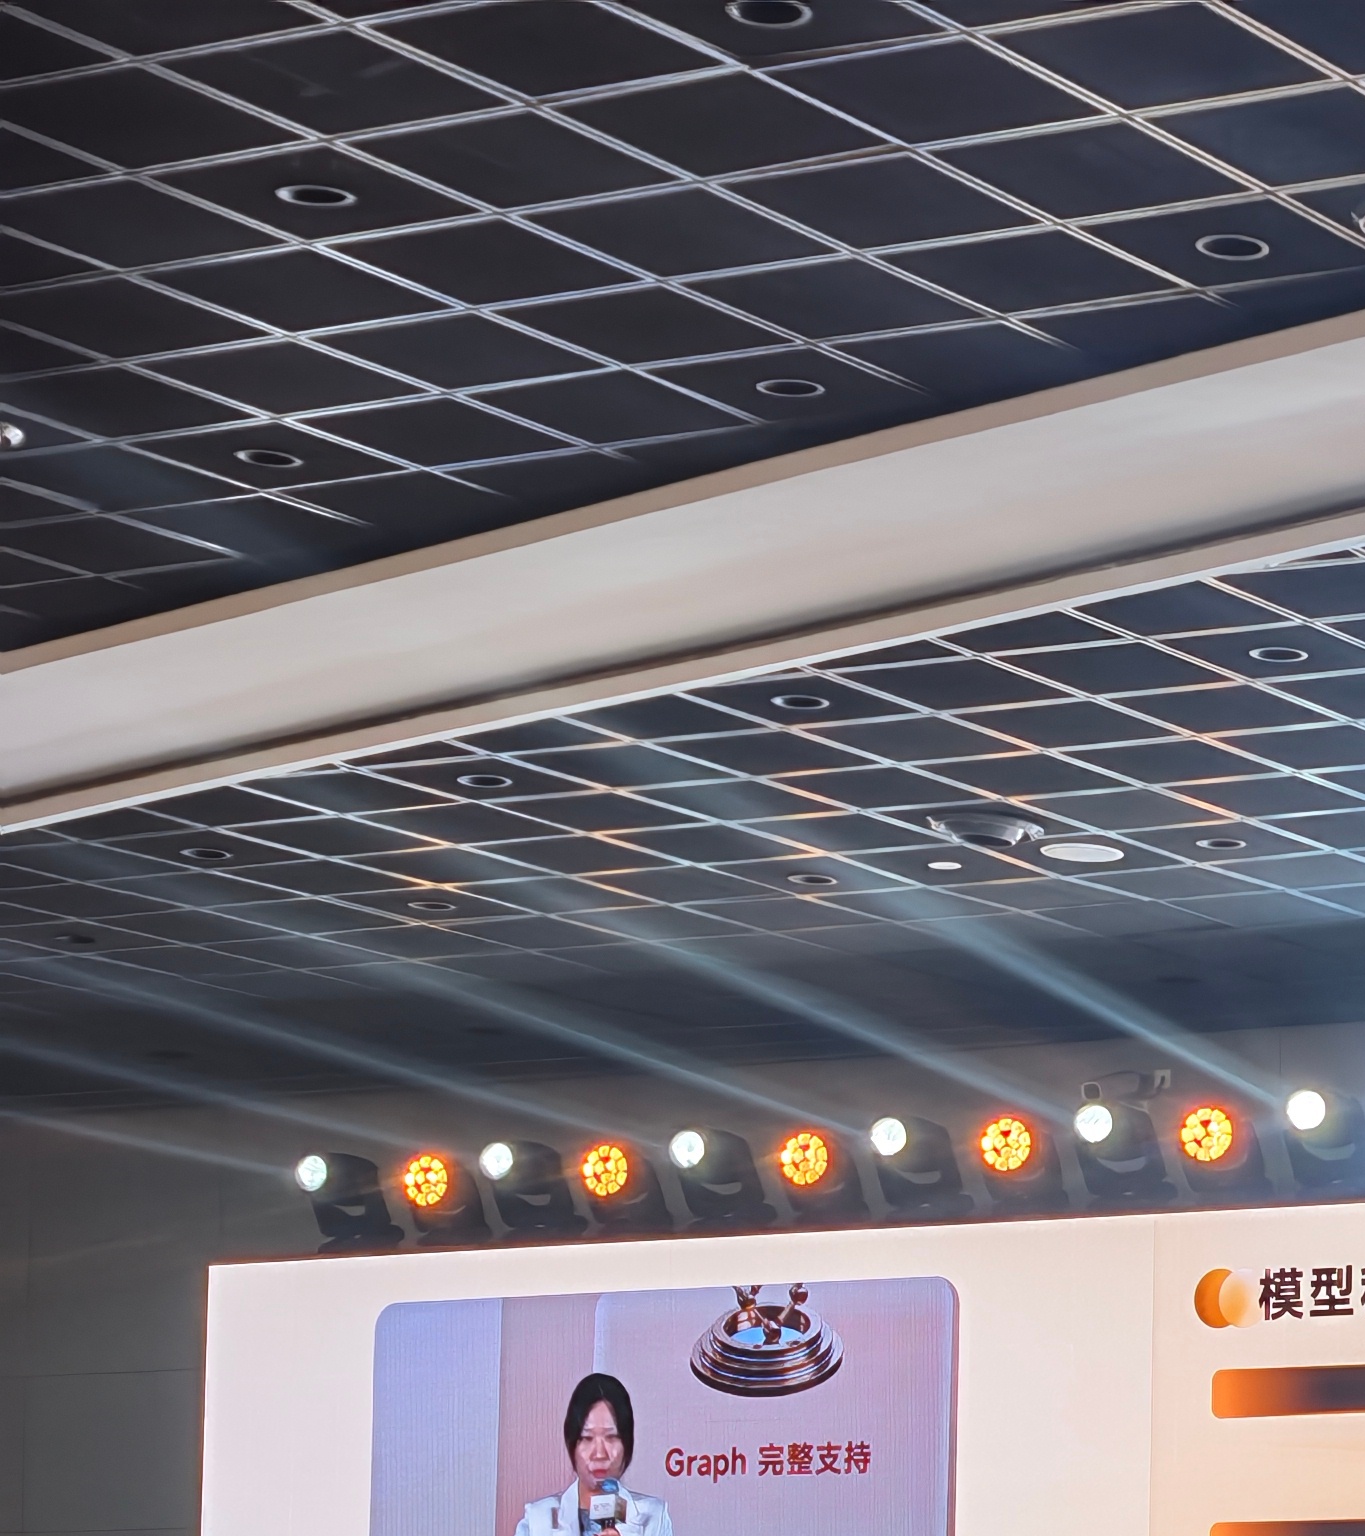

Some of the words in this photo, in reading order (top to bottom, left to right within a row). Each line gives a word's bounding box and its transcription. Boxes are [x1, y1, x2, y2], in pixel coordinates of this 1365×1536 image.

[665, 1447, 747, 1483] Graph
[758, 1440, 871, 1476] 完整支持
